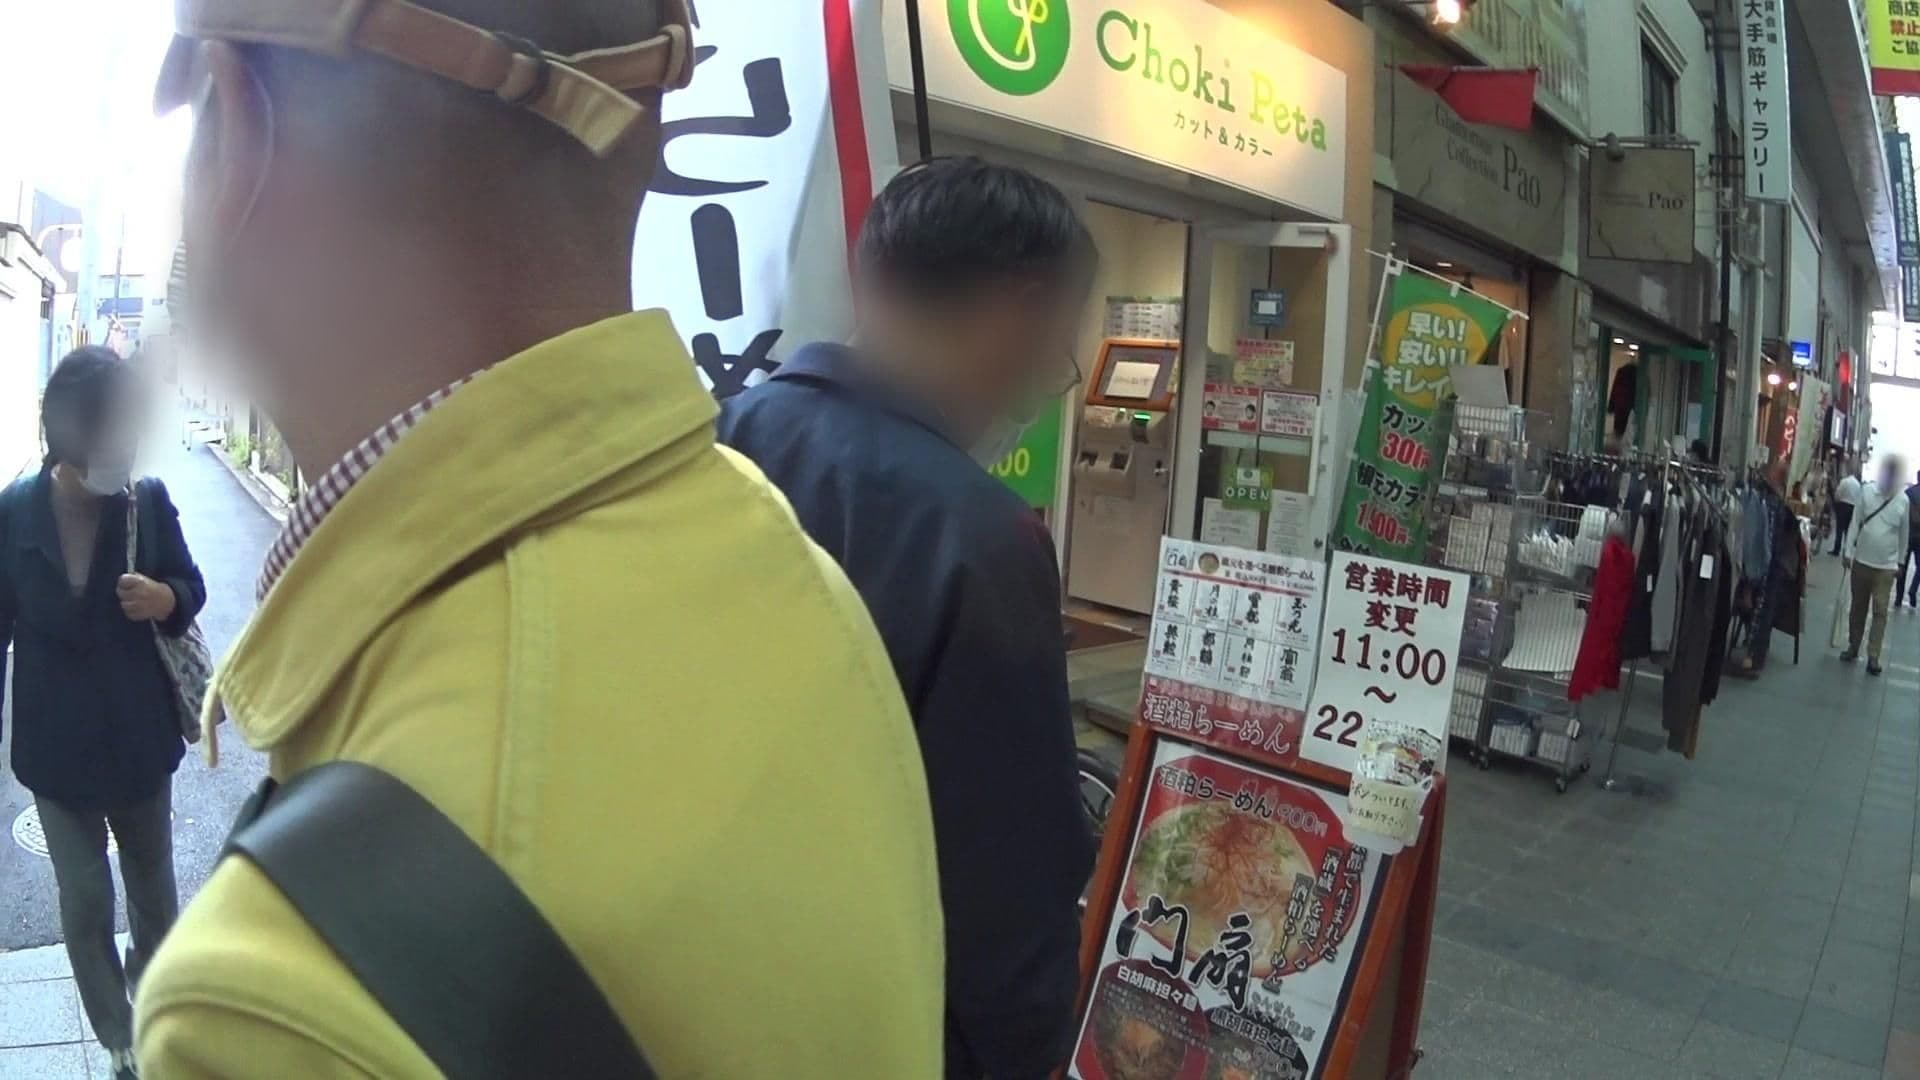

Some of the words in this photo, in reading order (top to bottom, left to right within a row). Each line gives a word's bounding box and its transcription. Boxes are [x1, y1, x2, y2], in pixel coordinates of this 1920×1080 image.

[1096, 9, 1236, 113] Choki
[1249, 69, 1327, 151] Peta
[1744, 0, 1769, 193] 大手筋ギャラリー
[1502, 143, 1541, 209] Pao
[1382, 404, 1433, 434] カッ
[1225, 487, 1270, 501] OPEN
[1344, 560, 1452, 609] 営業時間
[1364, 600, 1418, 637] 変更
[1331, 627, 1447, 686] 11:00
[1143, 692, 1290, 754] 酒粕らーめん
[1158, 764, 1273, 819] 酒粕らーめん
[1116, 964, 1200, 1013] 白胡麻担々麺
